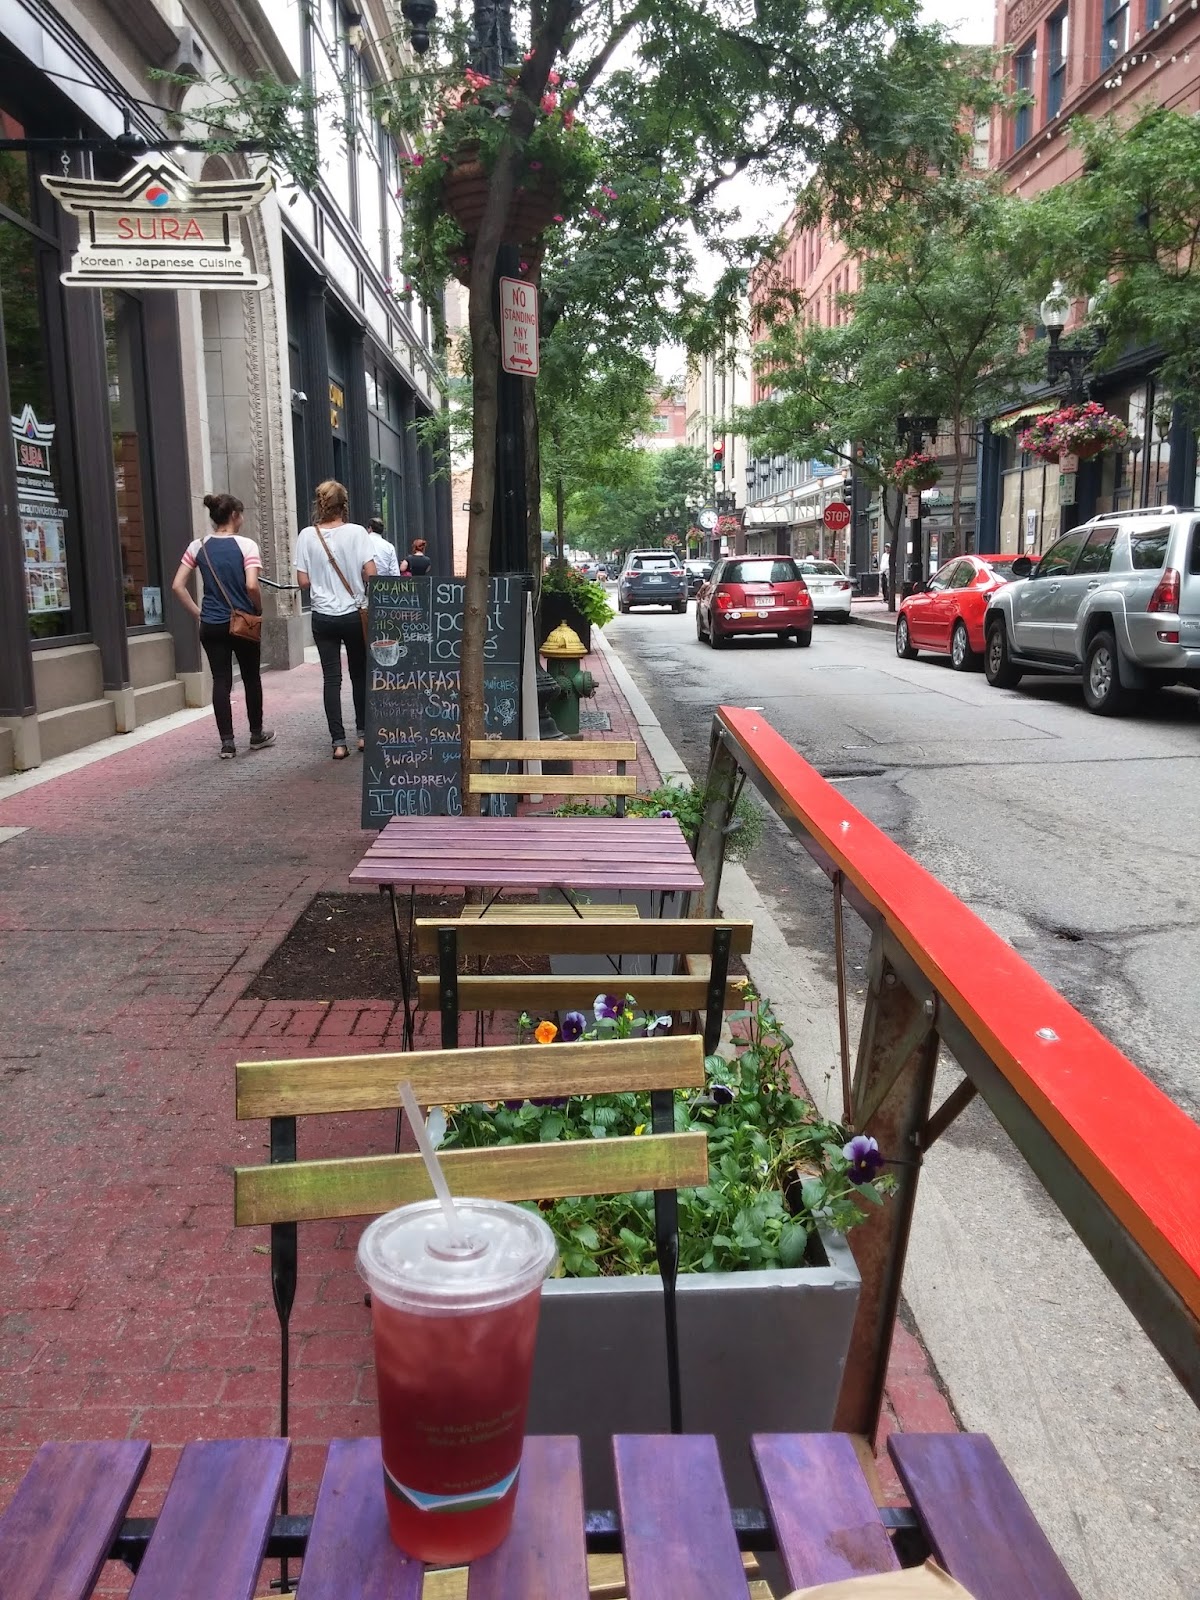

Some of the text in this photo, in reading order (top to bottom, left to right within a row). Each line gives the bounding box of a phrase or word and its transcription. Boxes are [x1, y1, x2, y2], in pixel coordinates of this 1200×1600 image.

[117, 217, 204, 241] SURA
[80, 256, 242, 269] Korean Japanese Cuisine
[512, 288, 526, 308] NO
[504, 308, 535, 326] STANDING
[513, 326, 528, 340] ANY
[513, 341, 529, 355] TIME
[20, 444, 44, 469] SURA
[18, 503, 69, 518] uraprovidence.com
[824, 510, 849, 522] STOP
[373, 580, 389, 592] YOU
[436, 577, 511, 604] smll
[373, 594, 420, 607] NEVAH
[390, 610, 422, 621] COFFEE
[434, 604, 504, 640] pot
[401, 621, 430, 632] GOOD
[436, 634, 498, 659] caé
[371, 669, 461, 691] BREAKFAST
[369, 788, 432, 817] ICED
